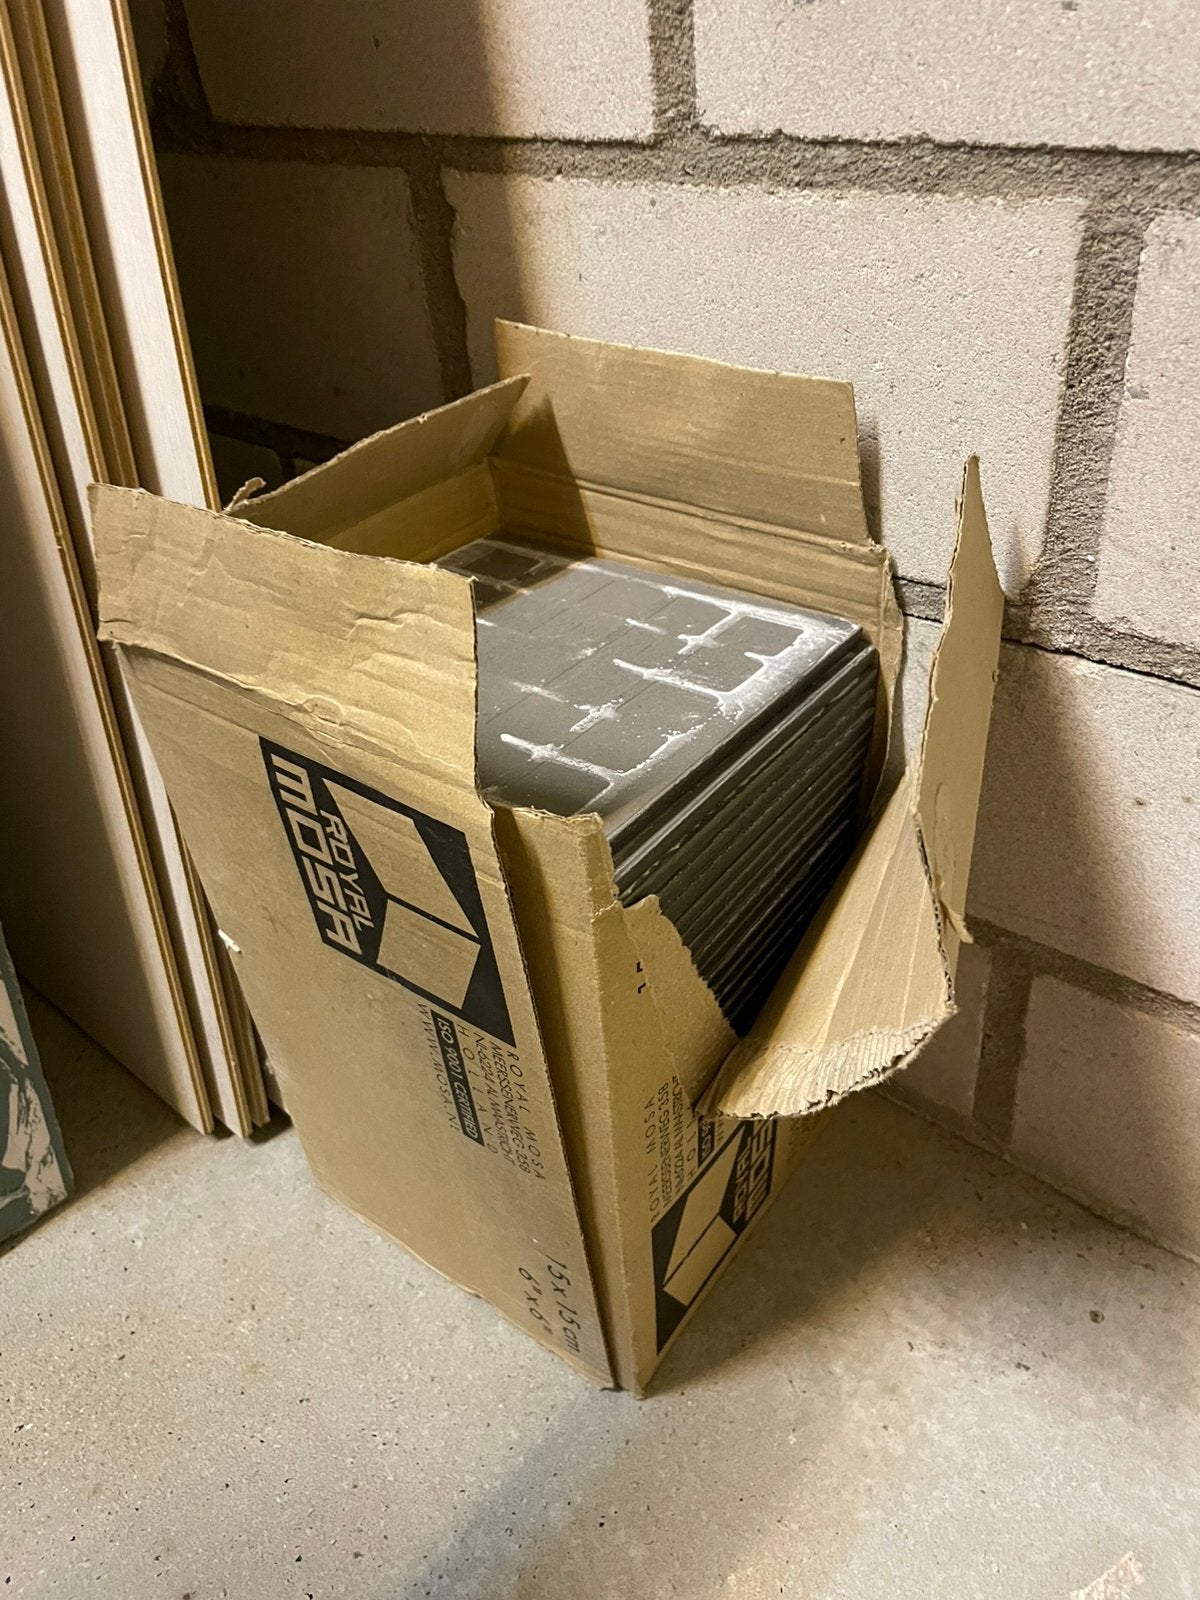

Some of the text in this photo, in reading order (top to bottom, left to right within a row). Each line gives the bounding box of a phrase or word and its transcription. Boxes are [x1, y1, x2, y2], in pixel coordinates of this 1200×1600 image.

[320, 809, 374, 932] ROYAL
[437, 1017, 478, 1139] ISO 9001 CERTIFIED
[456, 1023, 499, 1154] HOLLAND
[474, 1032, 494, 1085] NL-6224
[489, 1097, 515, 1167] MAASTRICHT
[490, 1041, 531, 1174] MEERSSENERWEG 358
[507, 1050, 546, 1180] ROYAL MOSA
[644, 1096, 657, 1154] MOSA
